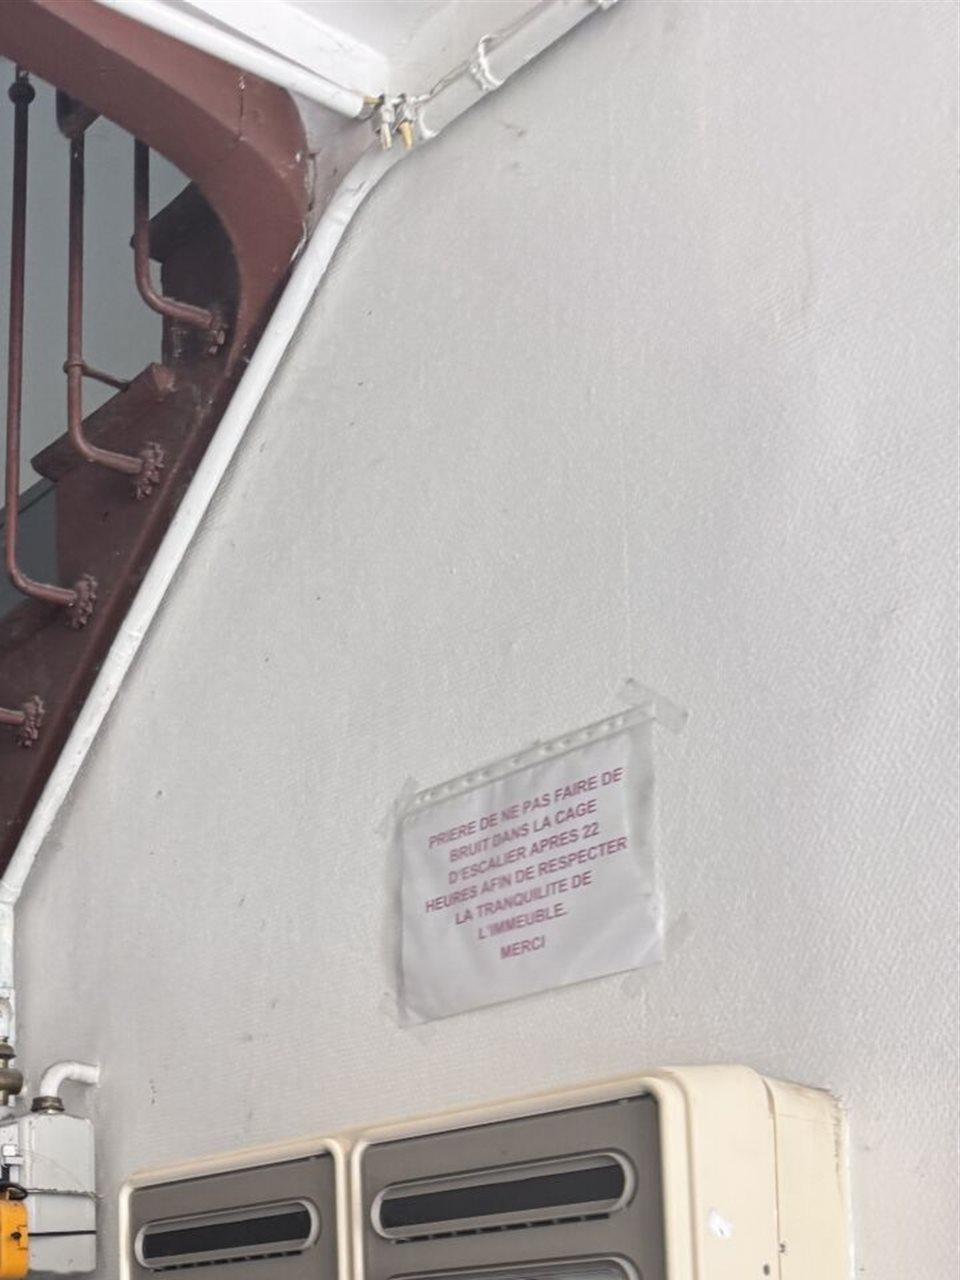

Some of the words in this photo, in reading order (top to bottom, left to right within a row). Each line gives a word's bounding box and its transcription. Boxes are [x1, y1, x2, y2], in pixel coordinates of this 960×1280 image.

[428, 820, 477, 848] PRIERE
[479, 812, 498, 831] DE
[501, 804, 520, 822] NE
[521, 793, 551, 815] PAS
[554, 775, 598, 803] FAIRE
[601, 767, 624, 786] DE
[449, 837, 491, 863] BRUIT
[492, 823, 529, 848] DANS
[532, 815, 552, 833] LA
[554, 798, 598, 825] CAGE
[425, 885, 478, 913] HEURES
[480, 873, 512, 895] AFIN
[515, 865, 536, 884] DE
[537, 836, 628, 876] RESPECTER
[448, 845, 527, 885] D'ESCALIER
[529, 828, 579, 857] APRES
[582, 821, 600, 840] 22
[455, 909, 474, 926] LA
[571, 870, 593, 890] DE
[499, 935, 546, 960] MERCI
